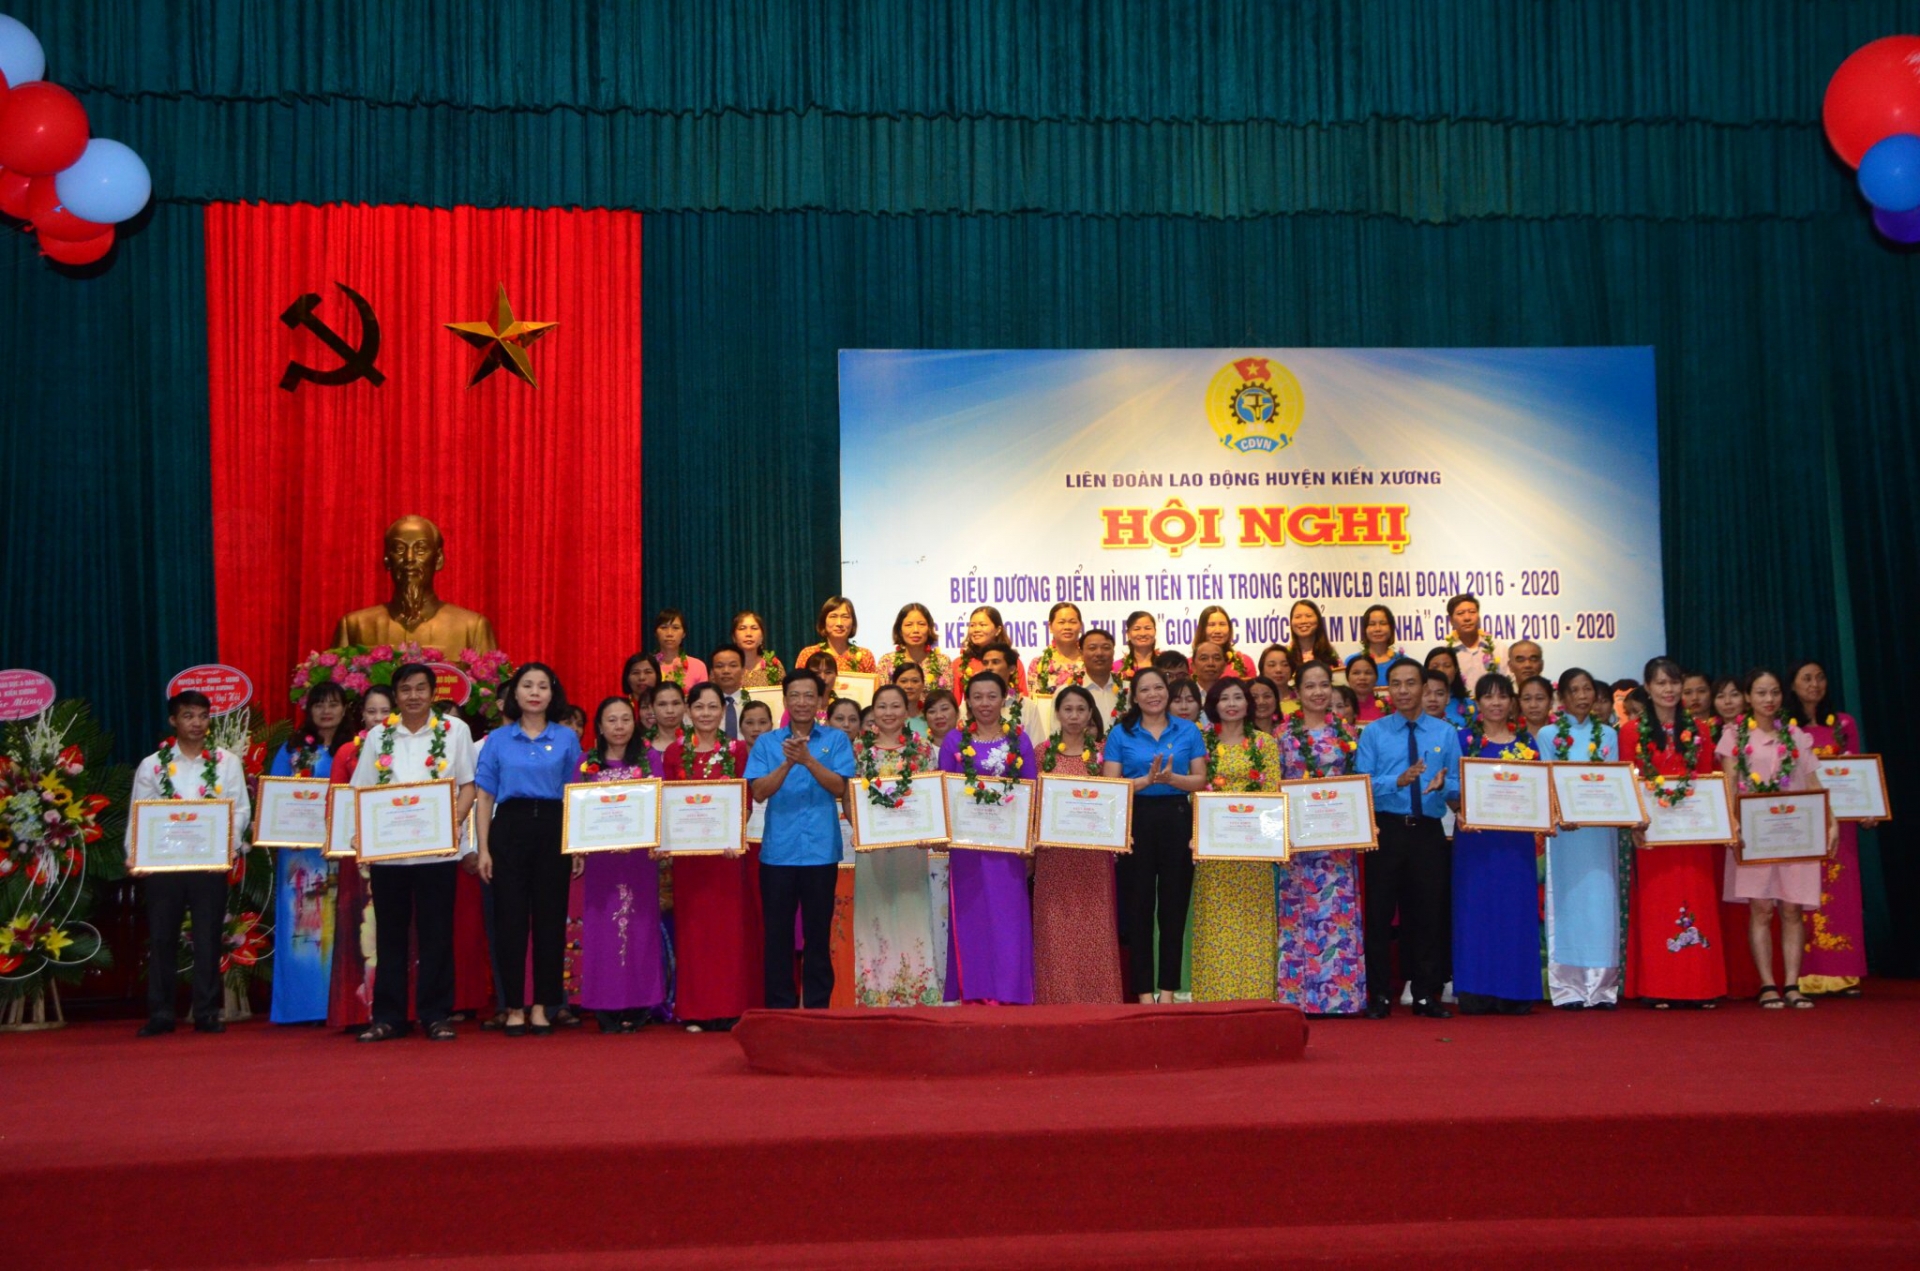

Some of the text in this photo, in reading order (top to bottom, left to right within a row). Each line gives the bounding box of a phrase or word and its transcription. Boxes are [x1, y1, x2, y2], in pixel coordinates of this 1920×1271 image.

[1066, 466, 1441, 490] LIÊN ĐOÀN LAO ĐỘNG HUYỆN KIẾN XƯƠNG
[1100, 495, 1411, 556] HỘI NGHỊ
[950, 565, 988, 603] BIỂU
[994, 573, 1050, 602] DƯƠNG
[1056, 564, 1095, 601] ĐIỂN
[1101, 569, 1140, 601] HÌNH
[1146, 568, 1181, 600] TIÊN
[1187, 565, 1223, 600] TIẾN
[1229, 573, 1282, 599] TRONG
[1288, 571, 1373, 598] CBCNVCLĐ
[1379, 571, 1410, 597] GIAI
[1416, 571, 1460, 602] ĐOẠN
[1466, 570, 1504, 596] 2016
[1521, 570, 1559, 595] 2020
[945, 612, 970, 648] KẾ
[1246, 609, 1290, 643] NƯỚC
[1522, 614, 1560, 640] 2010
[1577, 613, 1615, 639] 2020
